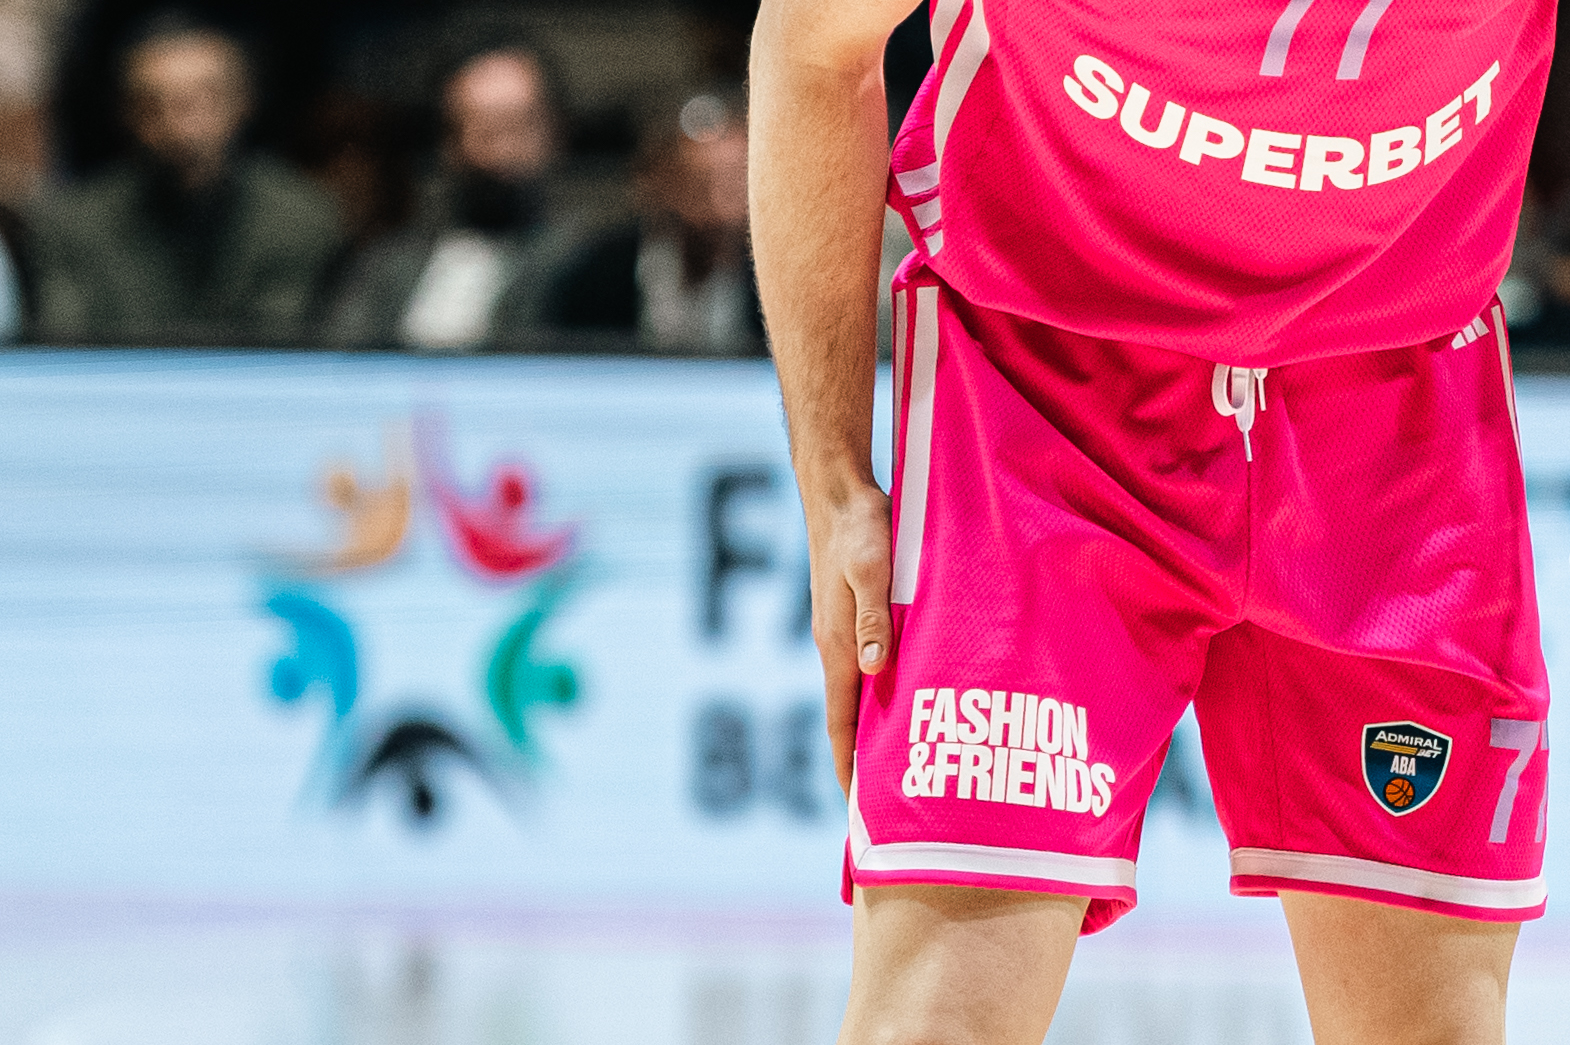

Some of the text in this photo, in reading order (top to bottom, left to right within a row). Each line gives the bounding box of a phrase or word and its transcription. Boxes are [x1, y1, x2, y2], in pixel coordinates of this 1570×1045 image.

[1062, 54, 1501, 192] SUPERBET
[908, 687, 1088, 760] FASHION
[1375, 730, 1443, 751] ADMIRAL
[1390, 754, 1416, 776] ABA
[1416, 748, 1442, 760] BET
[901, 741, 1116, 818] &FRIENDS
